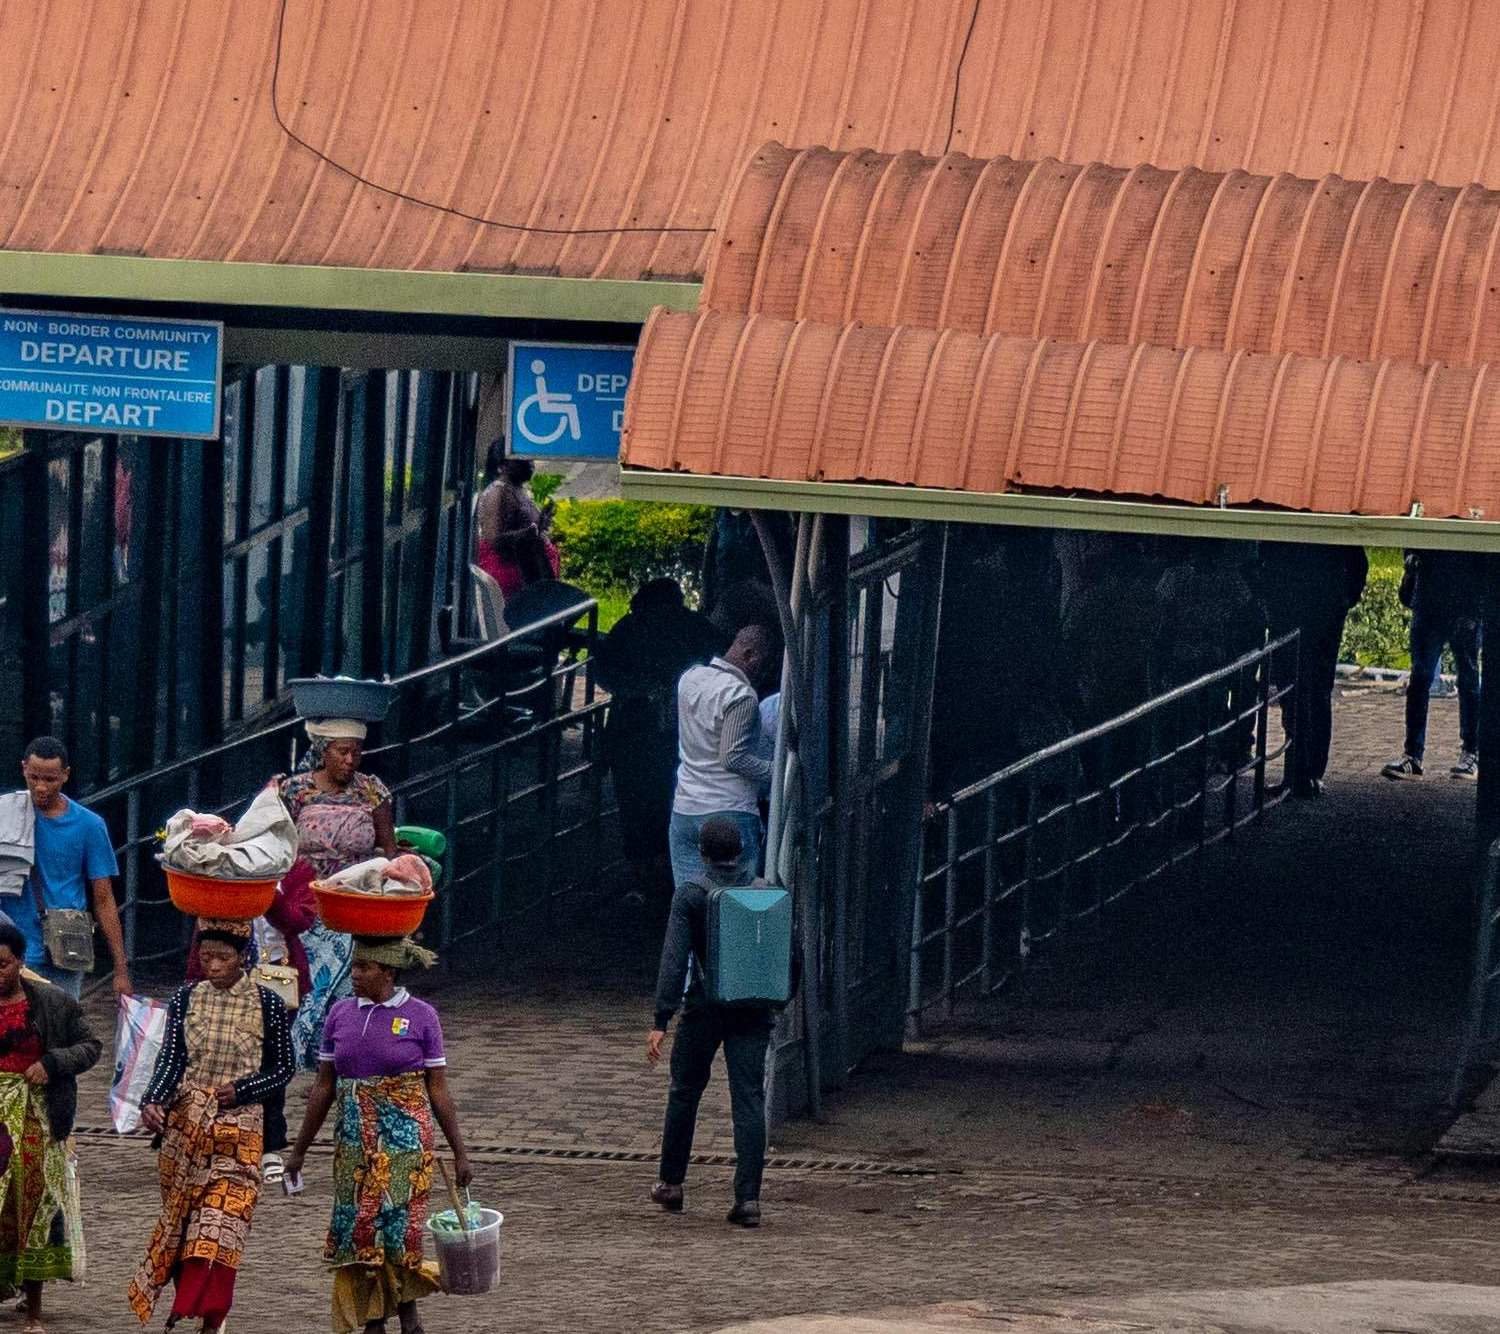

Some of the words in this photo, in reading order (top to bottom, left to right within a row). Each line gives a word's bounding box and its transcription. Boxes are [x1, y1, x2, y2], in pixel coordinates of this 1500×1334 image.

[48, 323, 110, 339] BORDER
[114, 327, 212, 345] COMMUNITY
[20, 340, 191, 372] DEPARTURE
[91, 386, 121, 398] NON
[124, 387, 212, 404] FRONTALIERE
[45, 399, 162, 428] DEPART
